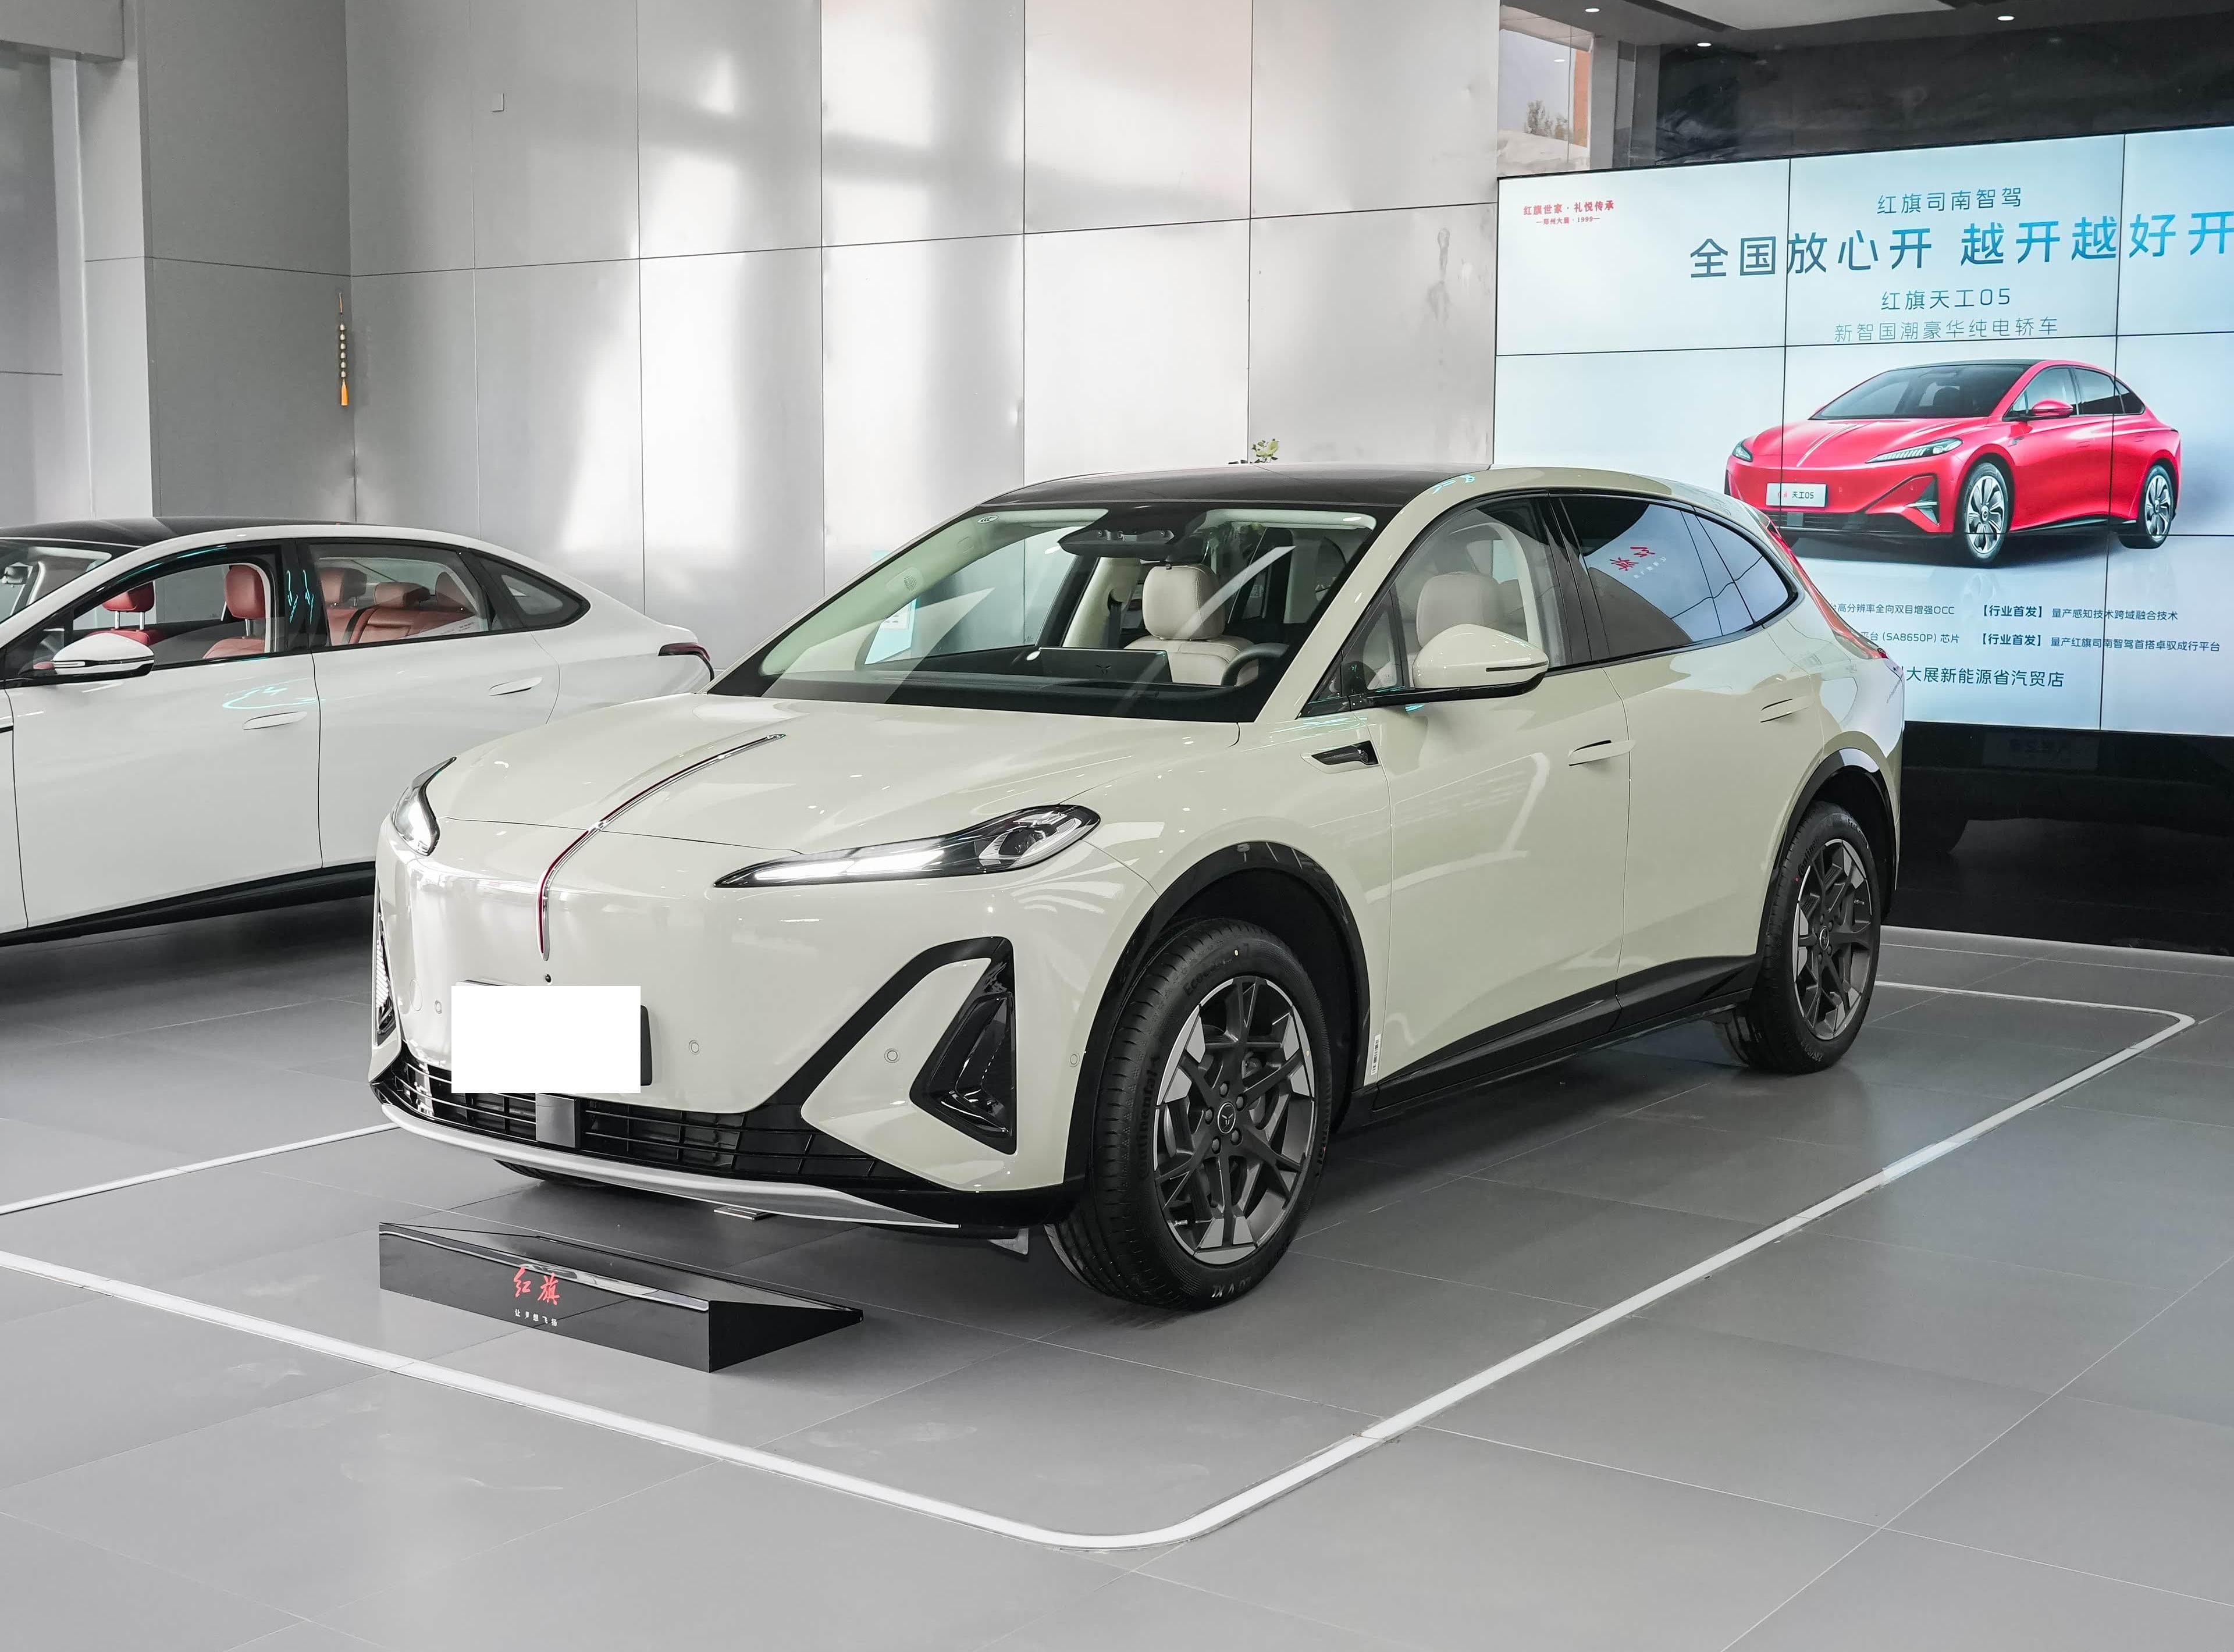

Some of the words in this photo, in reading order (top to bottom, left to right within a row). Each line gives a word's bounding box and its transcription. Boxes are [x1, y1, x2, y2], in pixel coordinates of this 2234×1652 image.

[1876, 187, 2022, 215] 红旗司南智驾
[1689, 227, 1932, 278] 全国放心开
[1960, 211, 2234, 266] 越开越好开
[1880, 288, 2011, 311] 红旗天工05
[1834, 316, 2058, 343] 新智国潮豪华纯电轿车
[2051, 608, 2179, 621] 量产感知技术跨域融合技术
[2050, 636, 2220, 652] 量产红旗司南智驾首搭卓驭成行平台
[1901, 665, 2065, 688] 大展新能源省汽贸店
[514, 1266, 560, 1306] 红旗
